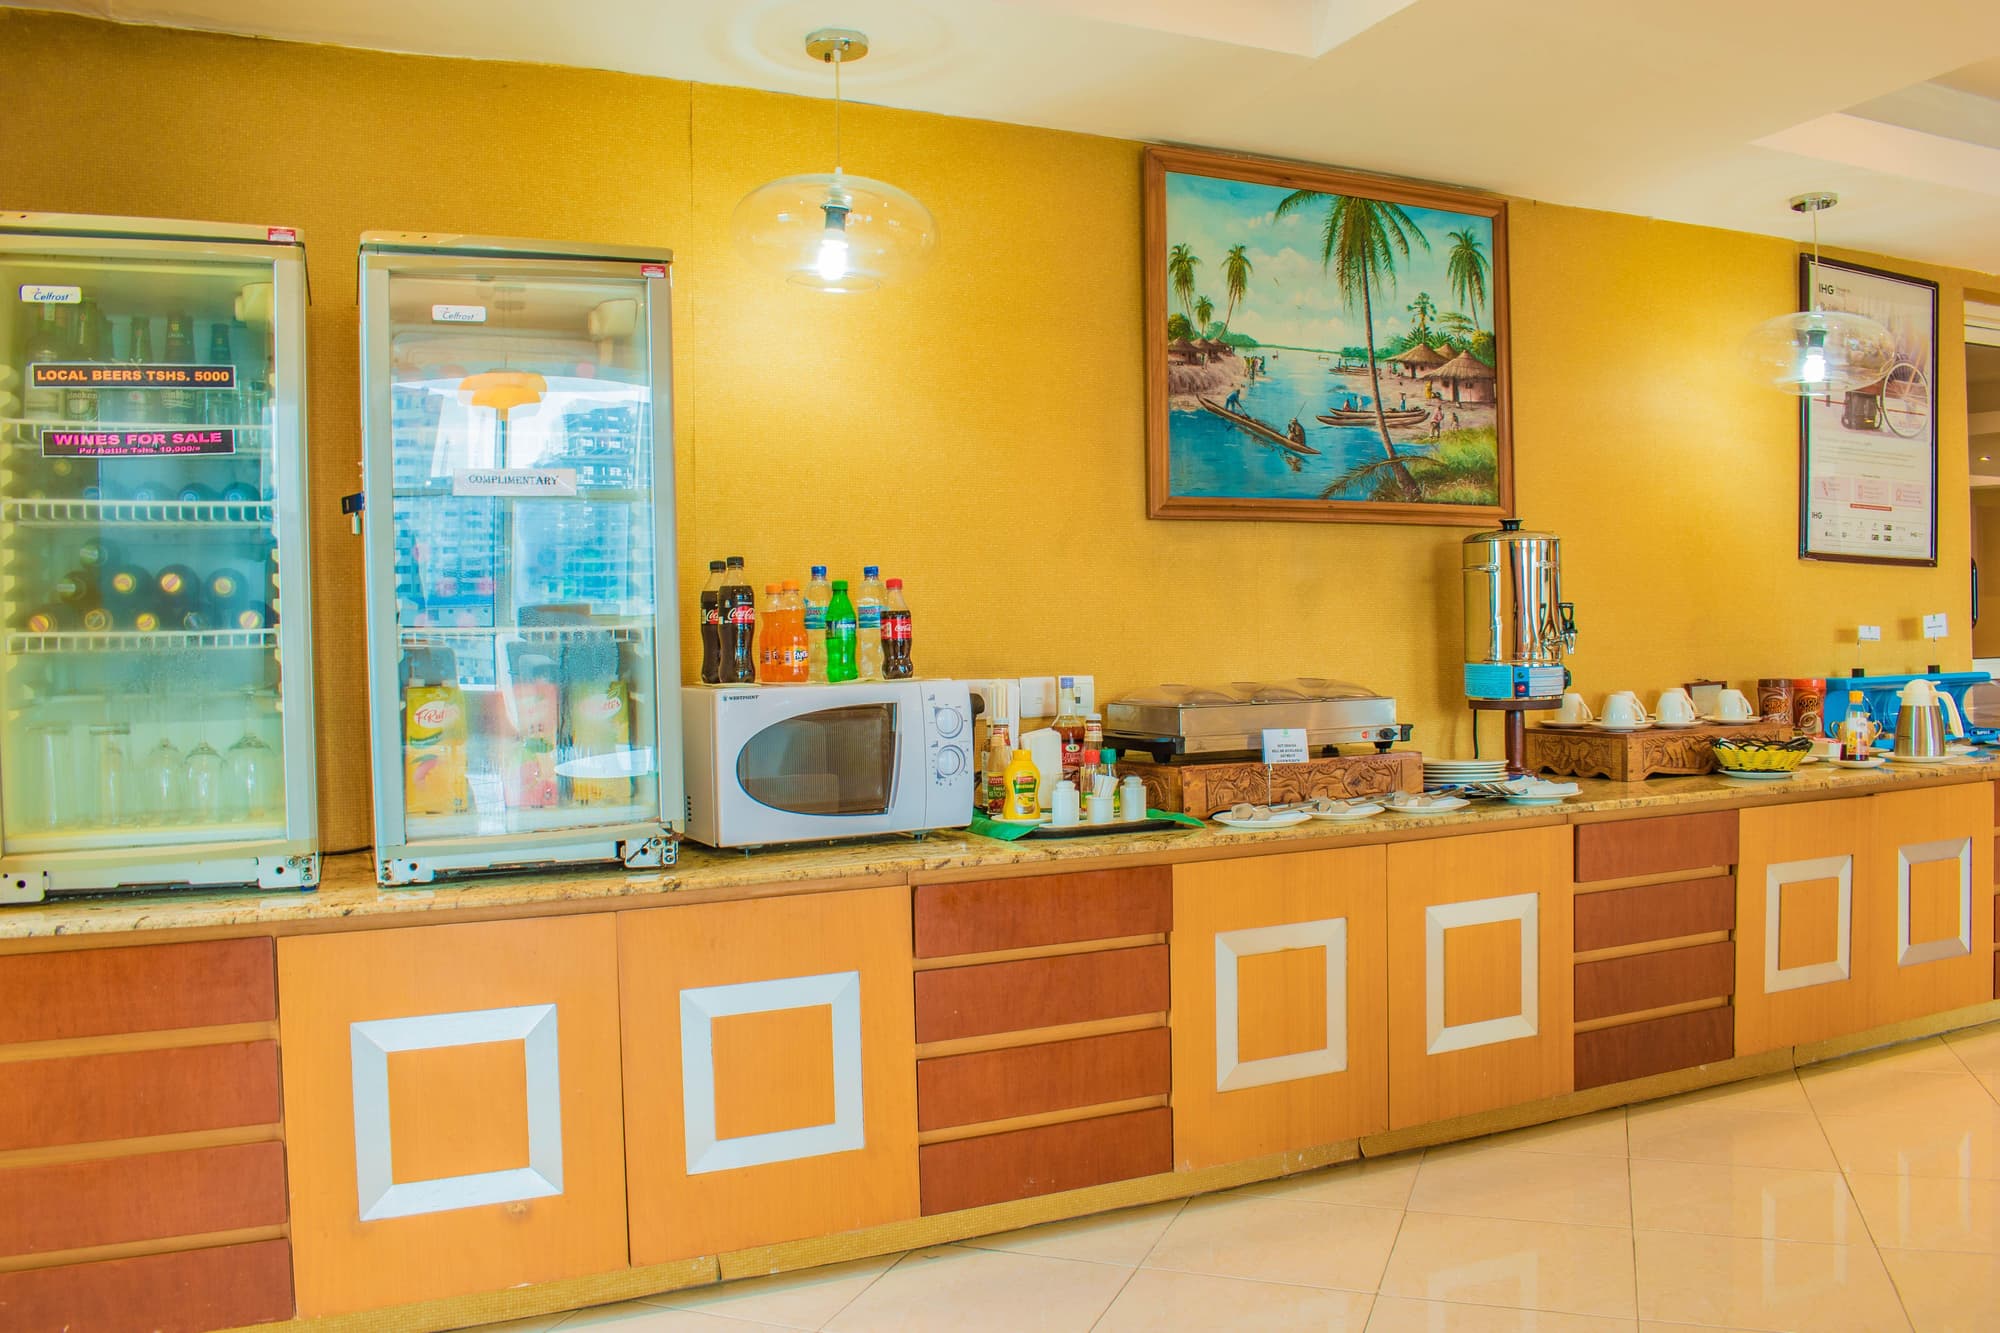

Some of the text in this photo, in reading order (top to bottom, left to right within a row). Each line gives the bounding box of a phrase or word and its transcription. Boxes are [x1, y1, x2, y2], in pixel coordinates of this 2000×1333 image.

[1818, 283, 1835, 295] IHG
[33, 290, 69, 301] Celfrost
[36, 370, 230, 382] LOCAL BEERS TSHS. 5000
[53, 432, 223, 446] WINES FOR SALE
[468, 475, 559, 485] COMPLIMENTARY
